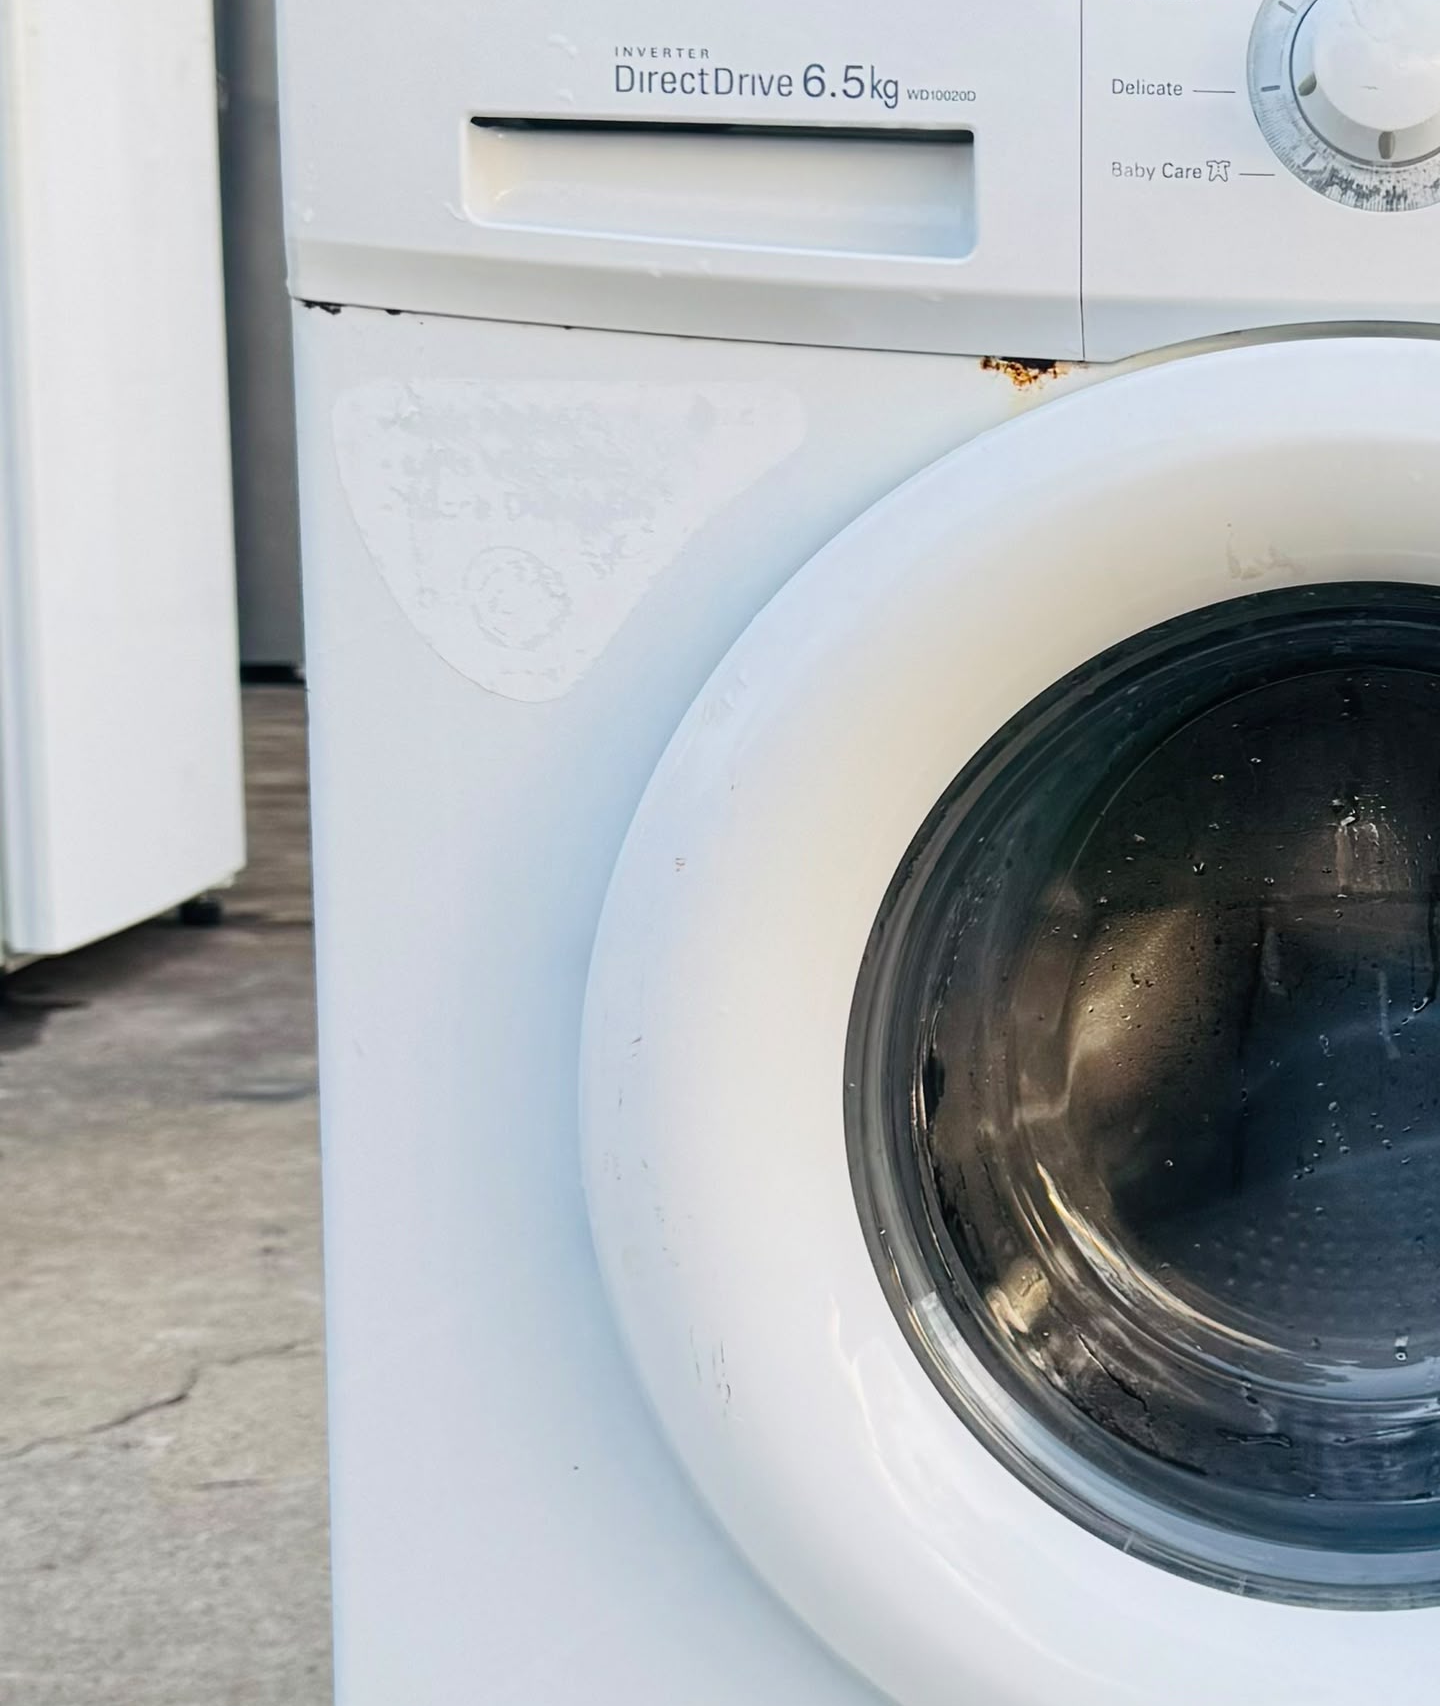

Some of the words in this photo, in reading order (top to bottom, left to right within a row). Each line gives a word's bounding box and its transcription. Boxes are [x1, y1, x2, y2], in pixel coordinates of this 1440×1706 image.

[615, 46, 710, 60] INVERTER
[803, 63, 899, 109] 6.5kg
[906, 89, 977, 102] WD10020D
[1111, 80, 1183, 97] Delicate
[1112, 161, 1155, 181] Baby
[1162, 162, 1202, 179] Care
